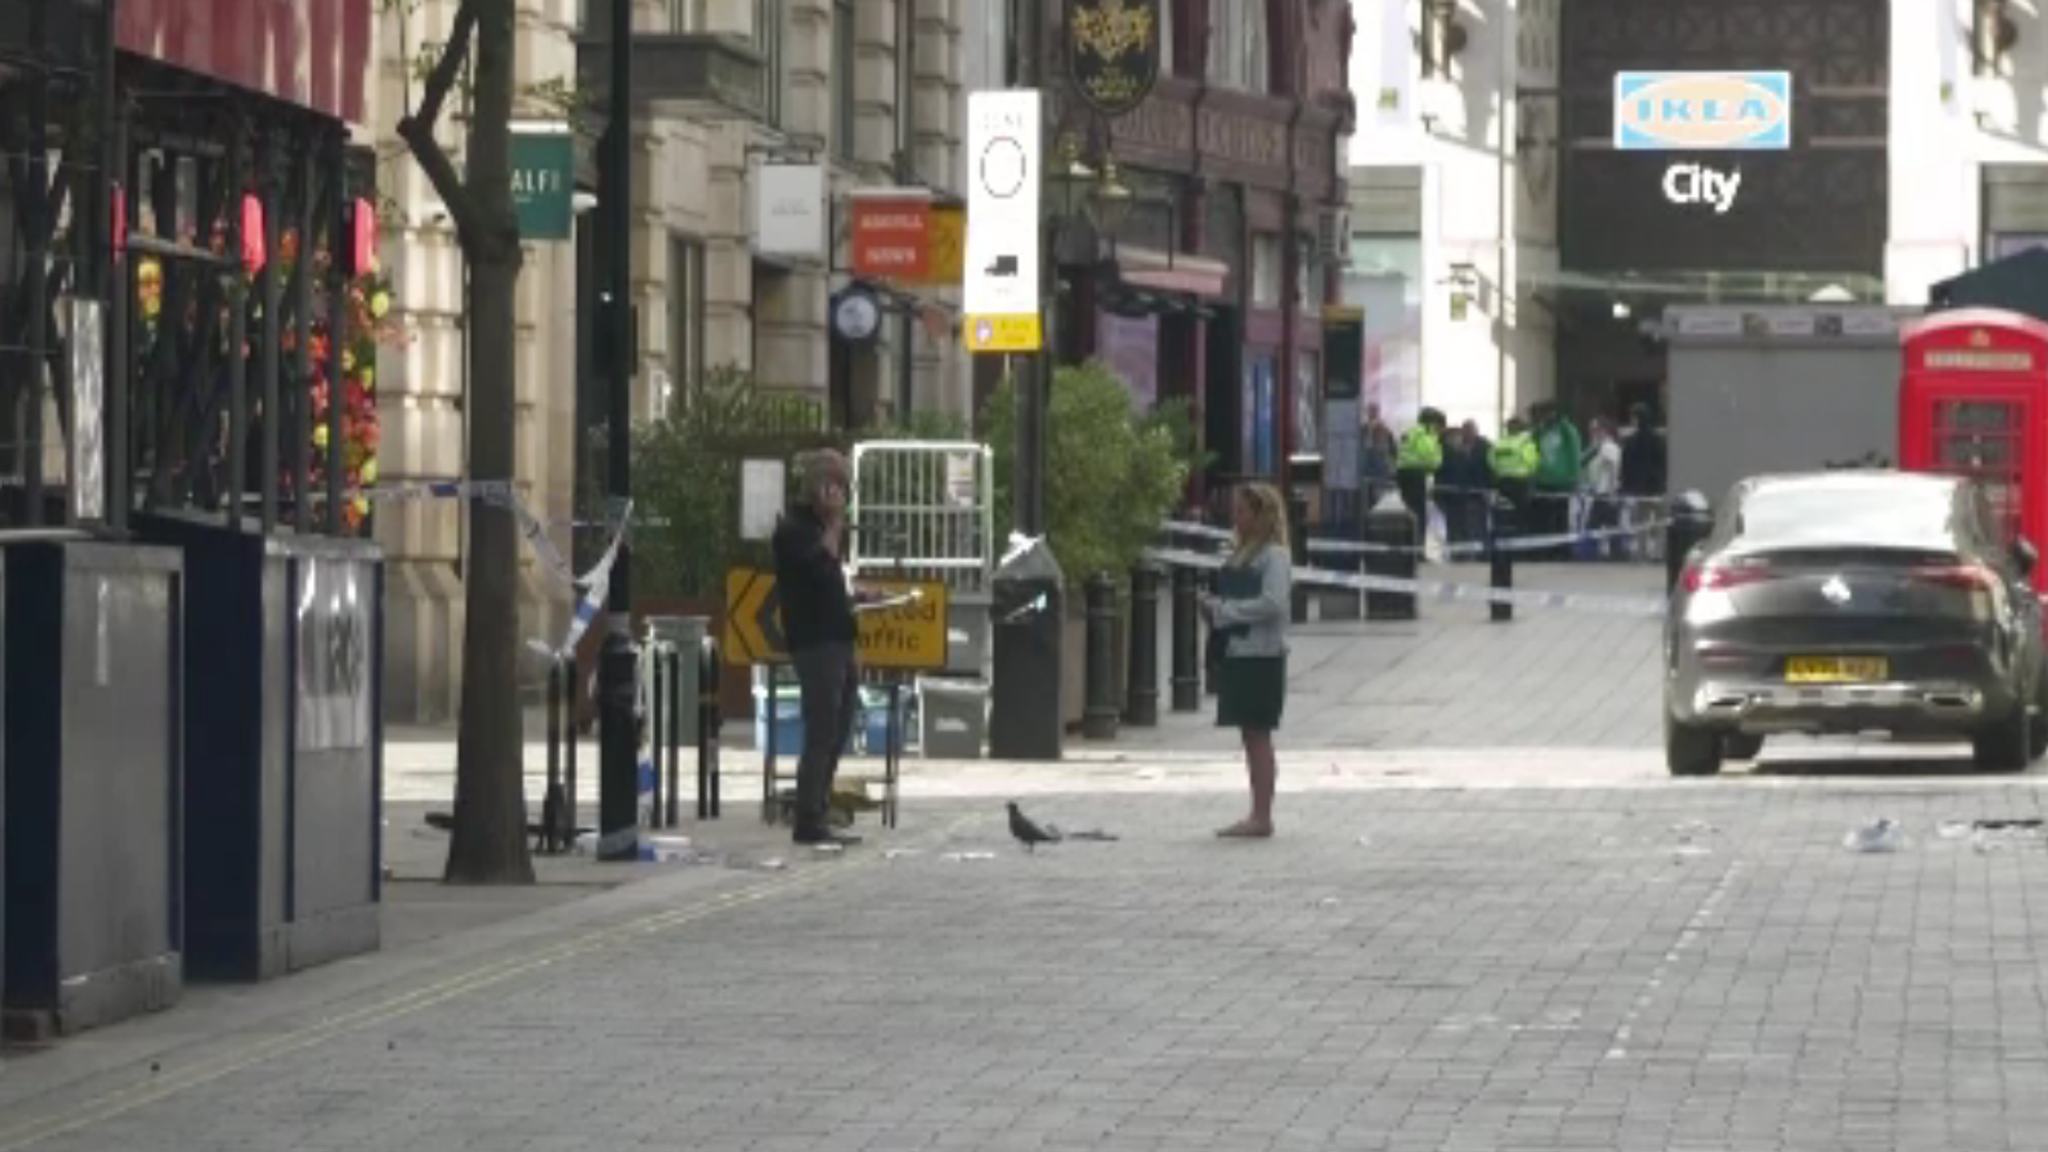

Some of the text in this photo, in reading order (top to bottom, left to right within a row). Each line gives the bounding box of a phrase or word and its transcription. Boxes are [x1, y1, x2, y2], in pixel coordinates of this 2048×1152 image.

[1637, 98, 1770, 124] IKEA
[1662, 163, 1741, 214] City
[861, 625, 920, 651] affic
